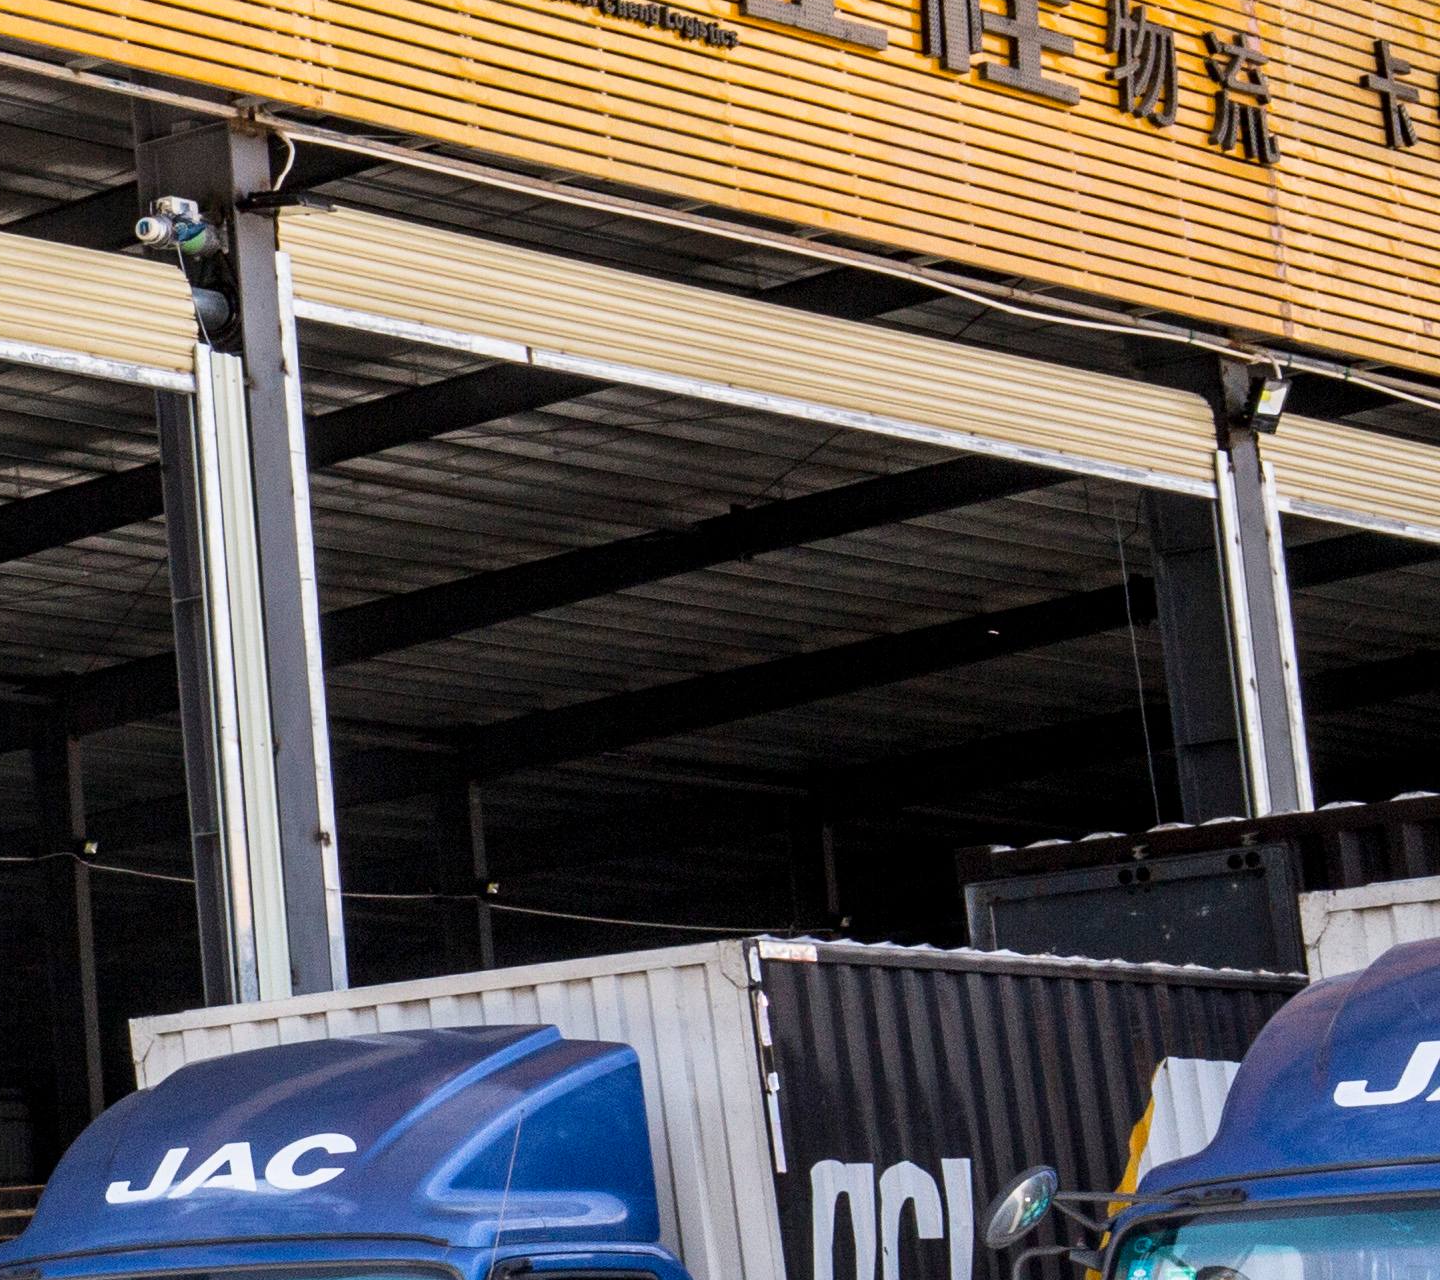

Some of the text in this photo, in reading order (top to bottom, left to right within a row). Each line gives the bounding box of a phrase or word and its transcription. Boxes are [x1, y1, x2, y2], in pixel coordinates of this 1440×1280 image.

[660, 5, 740, 50] Logistics
[1359, 39, 1440, 149] 卡
[1333, 1040, 1440, 1108] J
[105, 1133, 357, 1204] JAC
